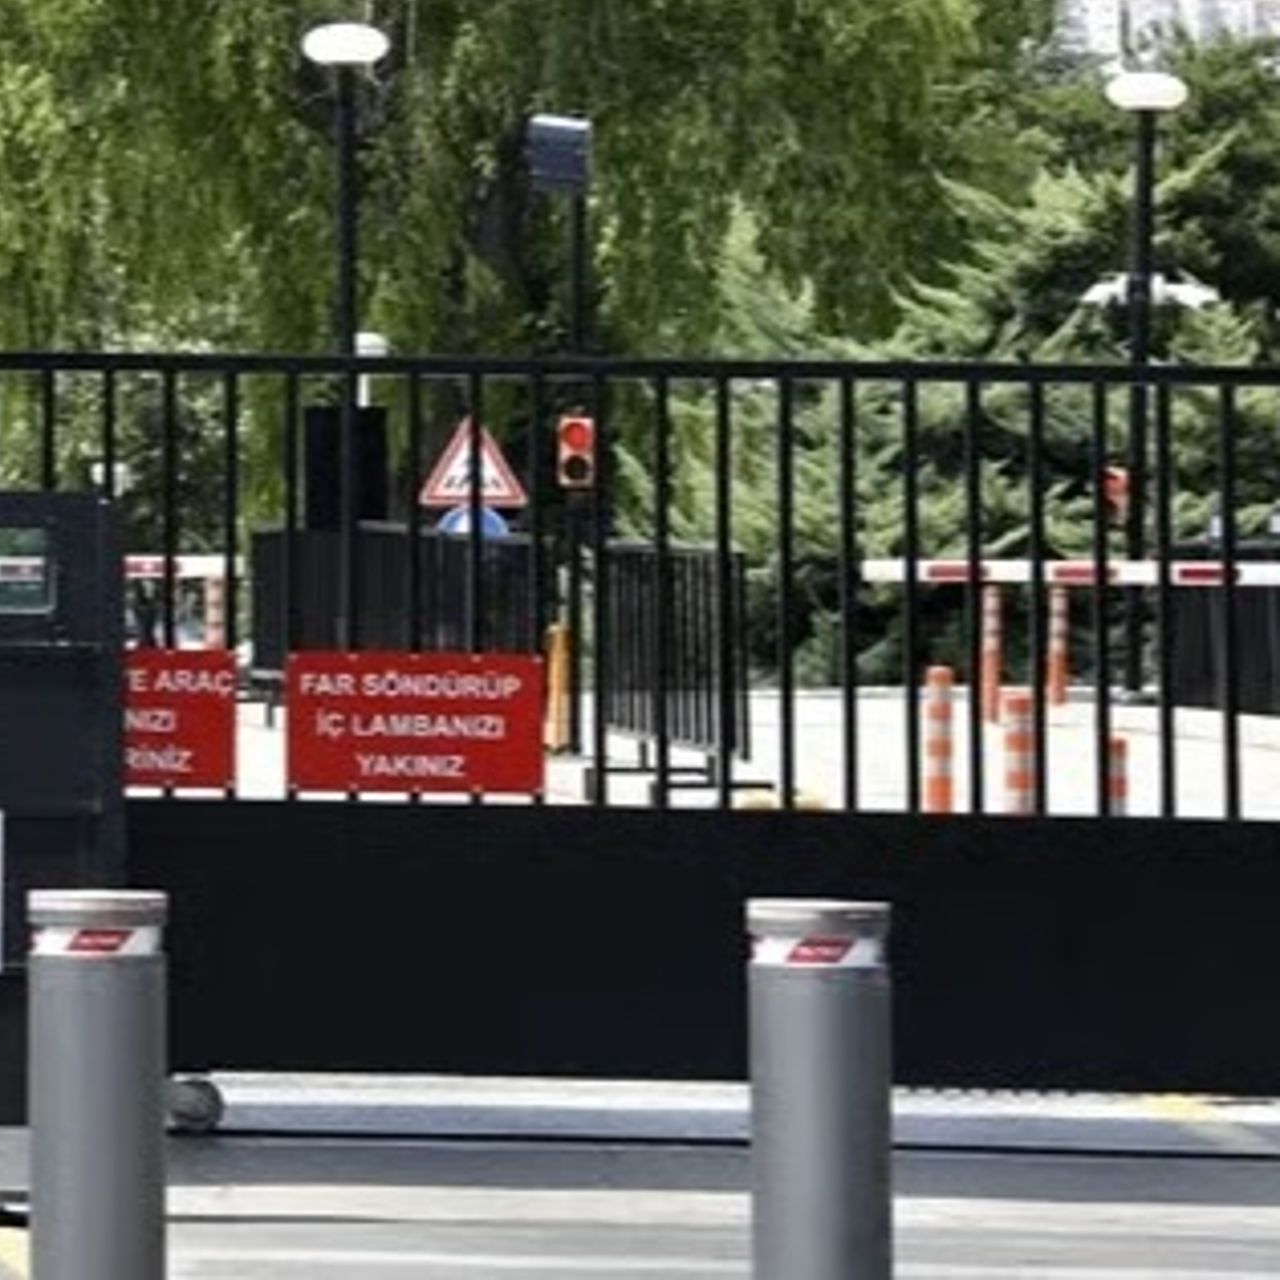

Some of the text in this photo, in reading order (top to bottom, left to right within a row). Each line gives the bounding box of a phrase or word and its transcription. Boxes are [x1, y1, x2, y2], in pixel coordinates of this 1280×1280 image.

[154, 669, 235, 697] ARAÇ
[300, 670, 522, 699] FAR SÖNDÜRÜP
[316, 708, 505, 740] İÇ LAMBANIZI
[355, 754, 466, 778] YAKINIZ
